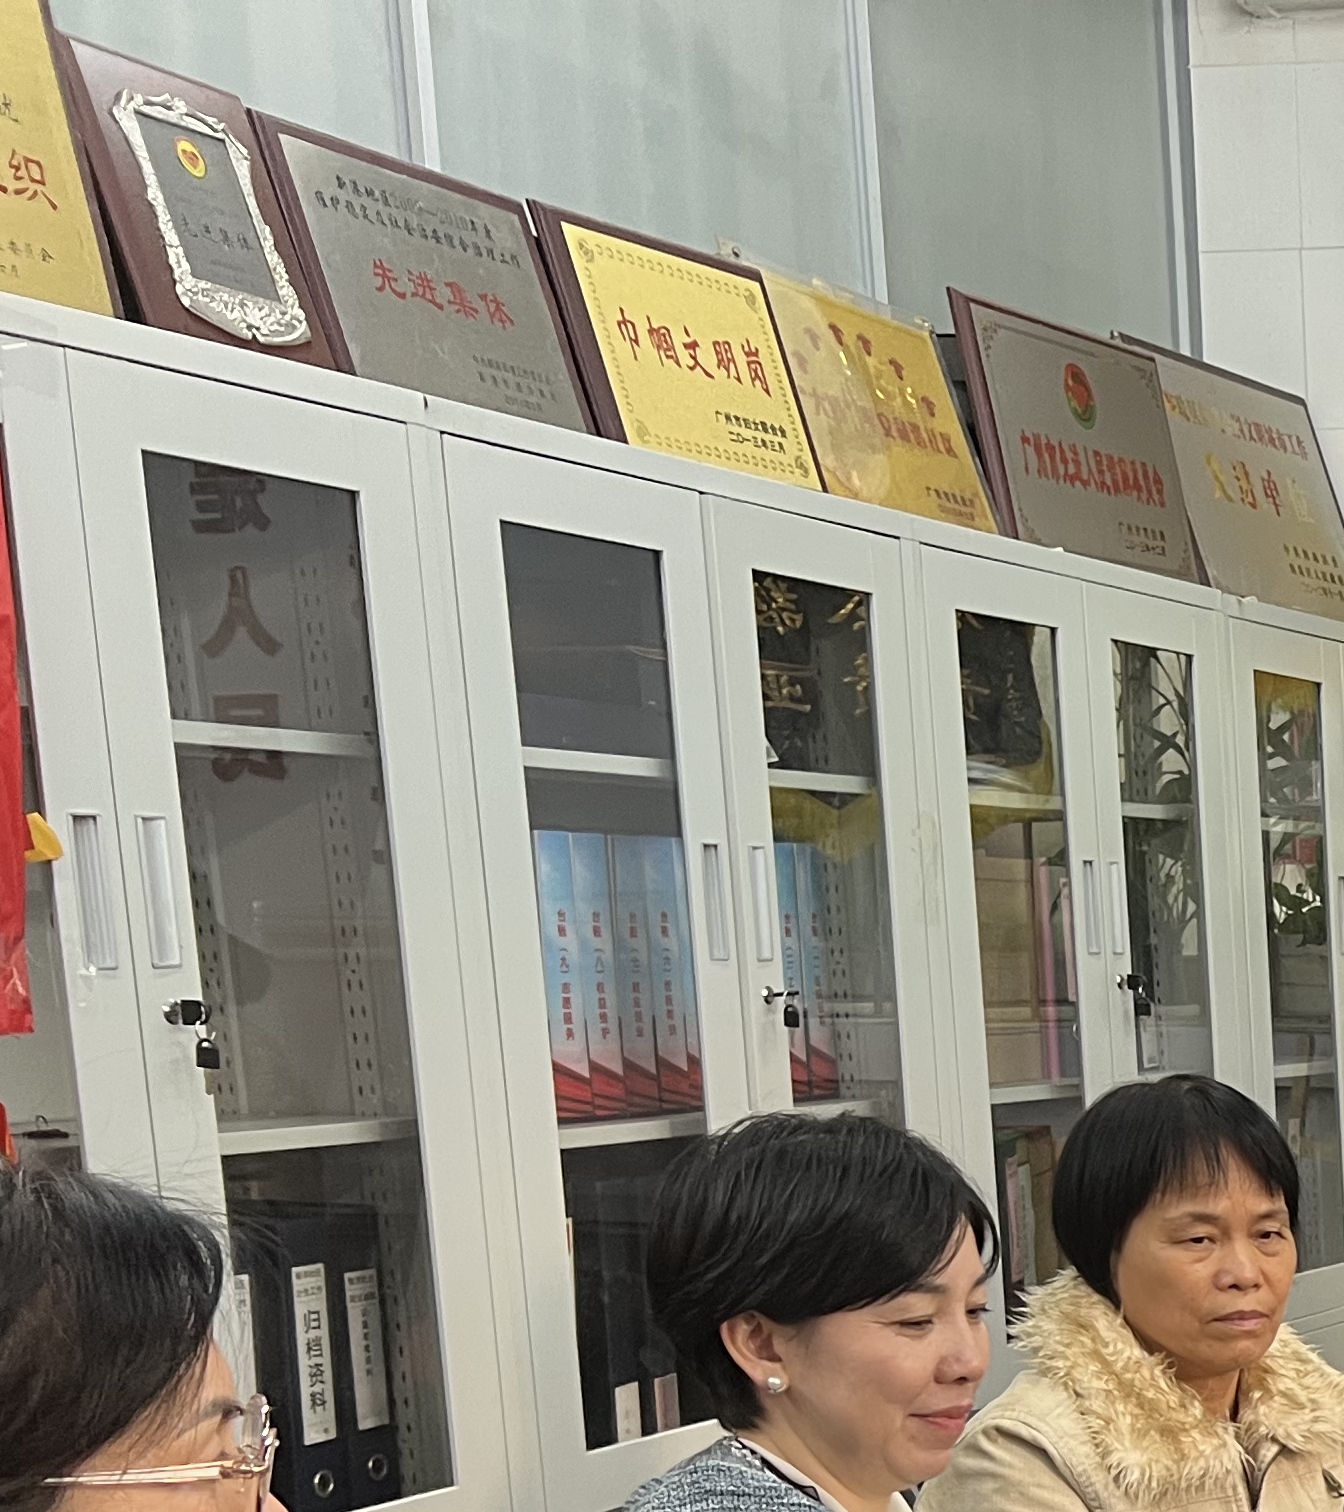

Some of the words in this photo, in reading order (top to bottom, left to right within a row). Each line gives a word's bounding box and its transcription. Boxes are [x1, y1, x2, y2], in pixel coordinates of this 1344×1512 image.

[0, 148, 58, 212] 织
[372, 257, 516, 331] 先进集体
[616, 305, 773, 399] 巾帼文明岗
[303, 1308, 329, 1415] 归档资料
